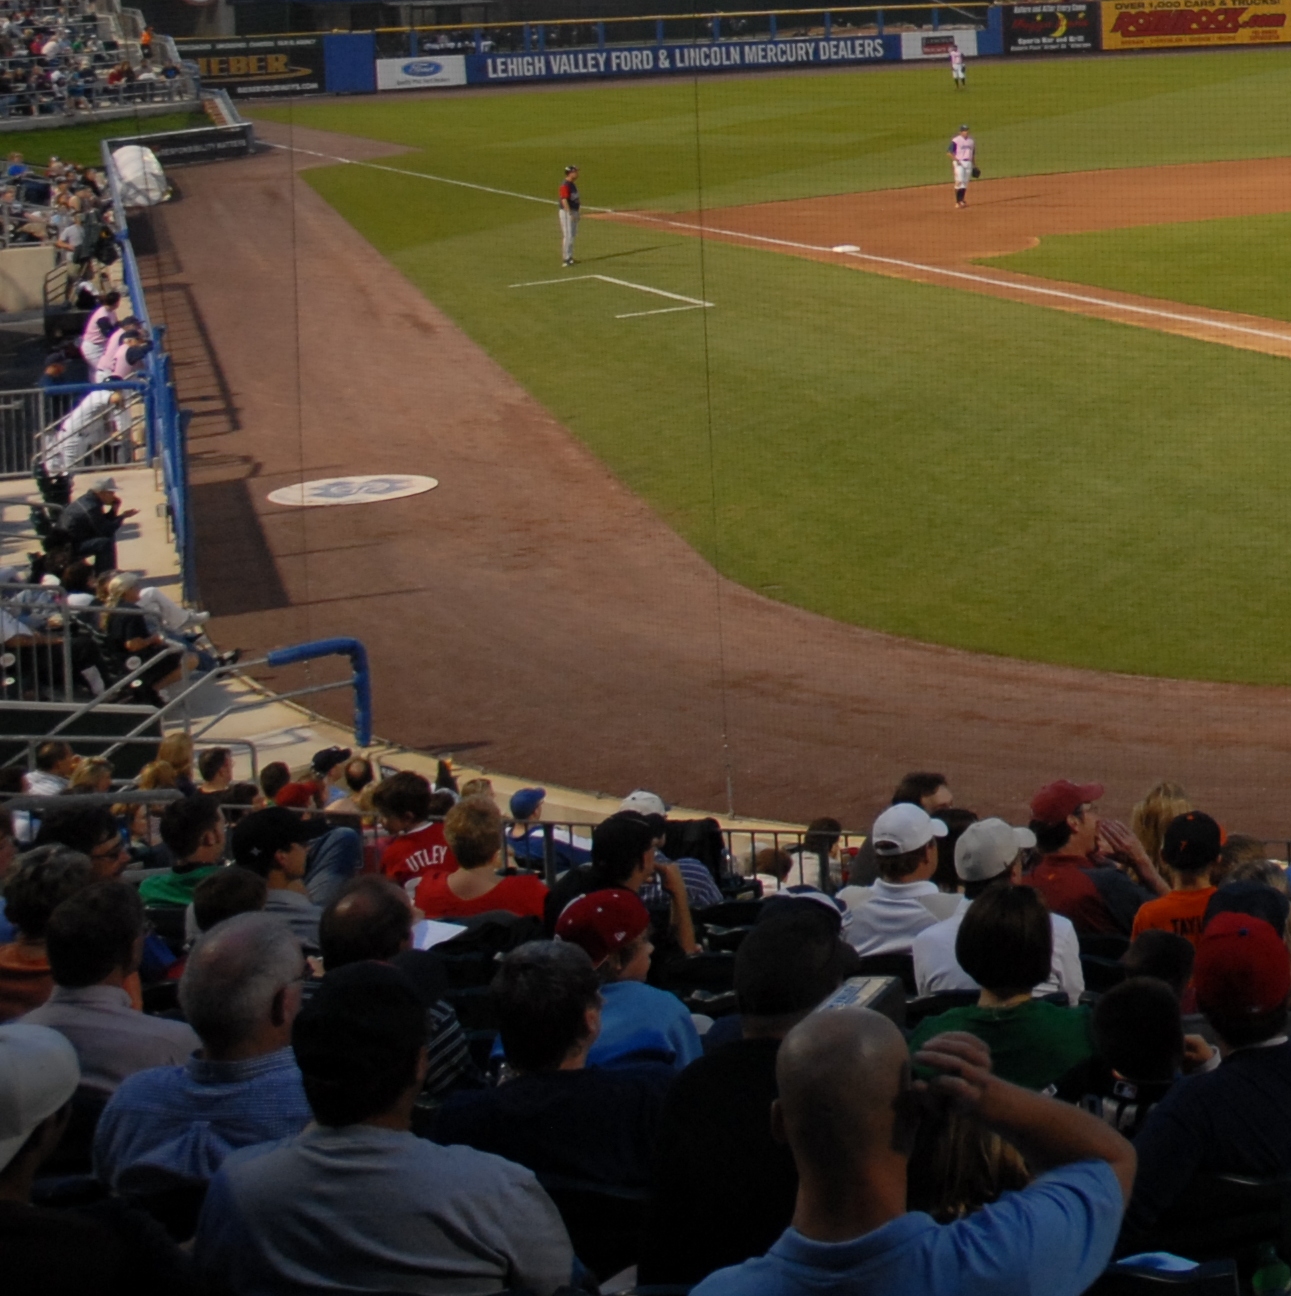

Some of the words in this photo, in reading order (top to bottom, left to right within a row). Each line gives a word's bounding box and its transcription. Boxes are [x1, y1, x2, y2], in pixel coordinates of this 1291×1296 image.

[1115, 2, 1145, 10] OVER
[1149, 0, 1181, 9] 1,000
[1185, 0, 1216, 8] CARS
[487, 56, 546, 79] LEHIGH
[550, 53, 608, 74] VALLEY
[611, 50, 653, 71] FORD
[658, 50, 671, 68] &
[676, 45, 741, 67] LINCOLN
[744, 42, 815, 64] MERCURY
[819, 39, 884, 60] DEALERS
[405, 844, 448, 873] UTLEY
